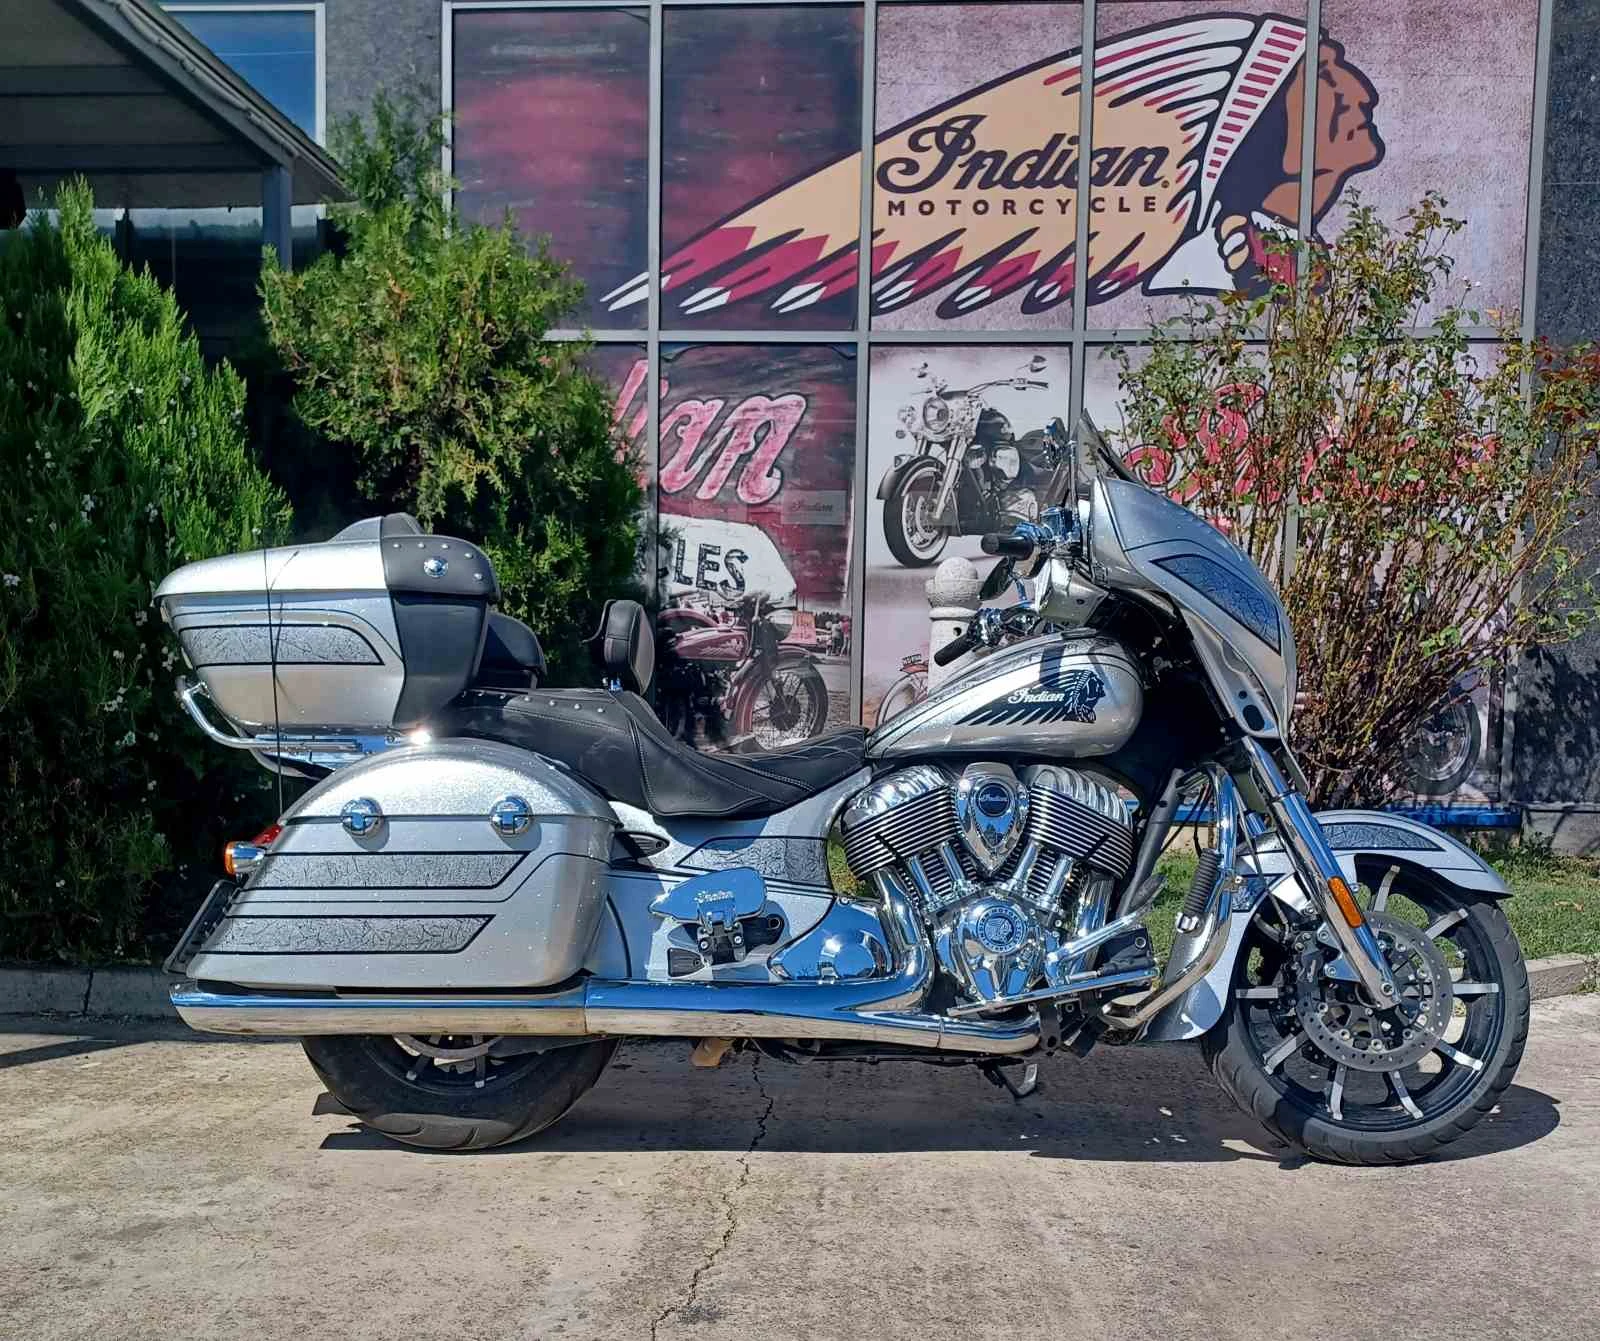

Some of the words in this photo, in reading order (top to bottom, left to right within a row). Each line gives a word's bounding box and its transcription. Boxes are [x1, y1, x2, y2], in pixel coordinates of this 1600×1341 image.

[876, 114, 1170, 194] Indian
[888, 196, 1156, 216] MOTORCYCLE
[1007, 687, 1066, 704] Indian
